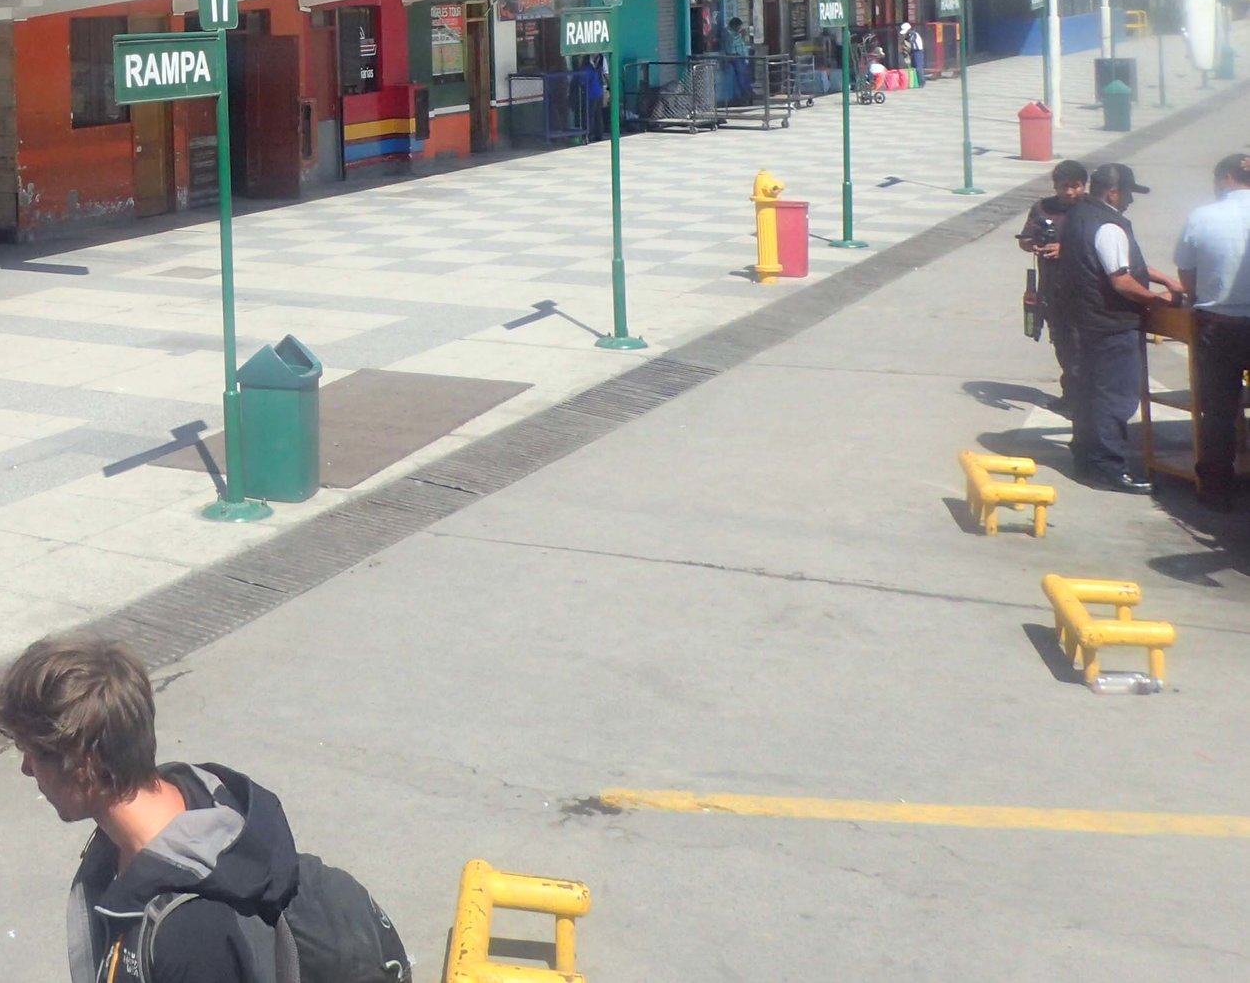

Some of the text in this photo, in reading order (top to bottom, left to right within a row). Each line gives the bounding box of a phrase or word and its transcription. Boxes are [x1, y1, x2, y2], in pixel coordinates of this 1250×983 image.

[819, 1, 844, 20] RAMPA
[566, 20, 610, 45] RAMPA
[124, 50, 211, 88] RAMPA
